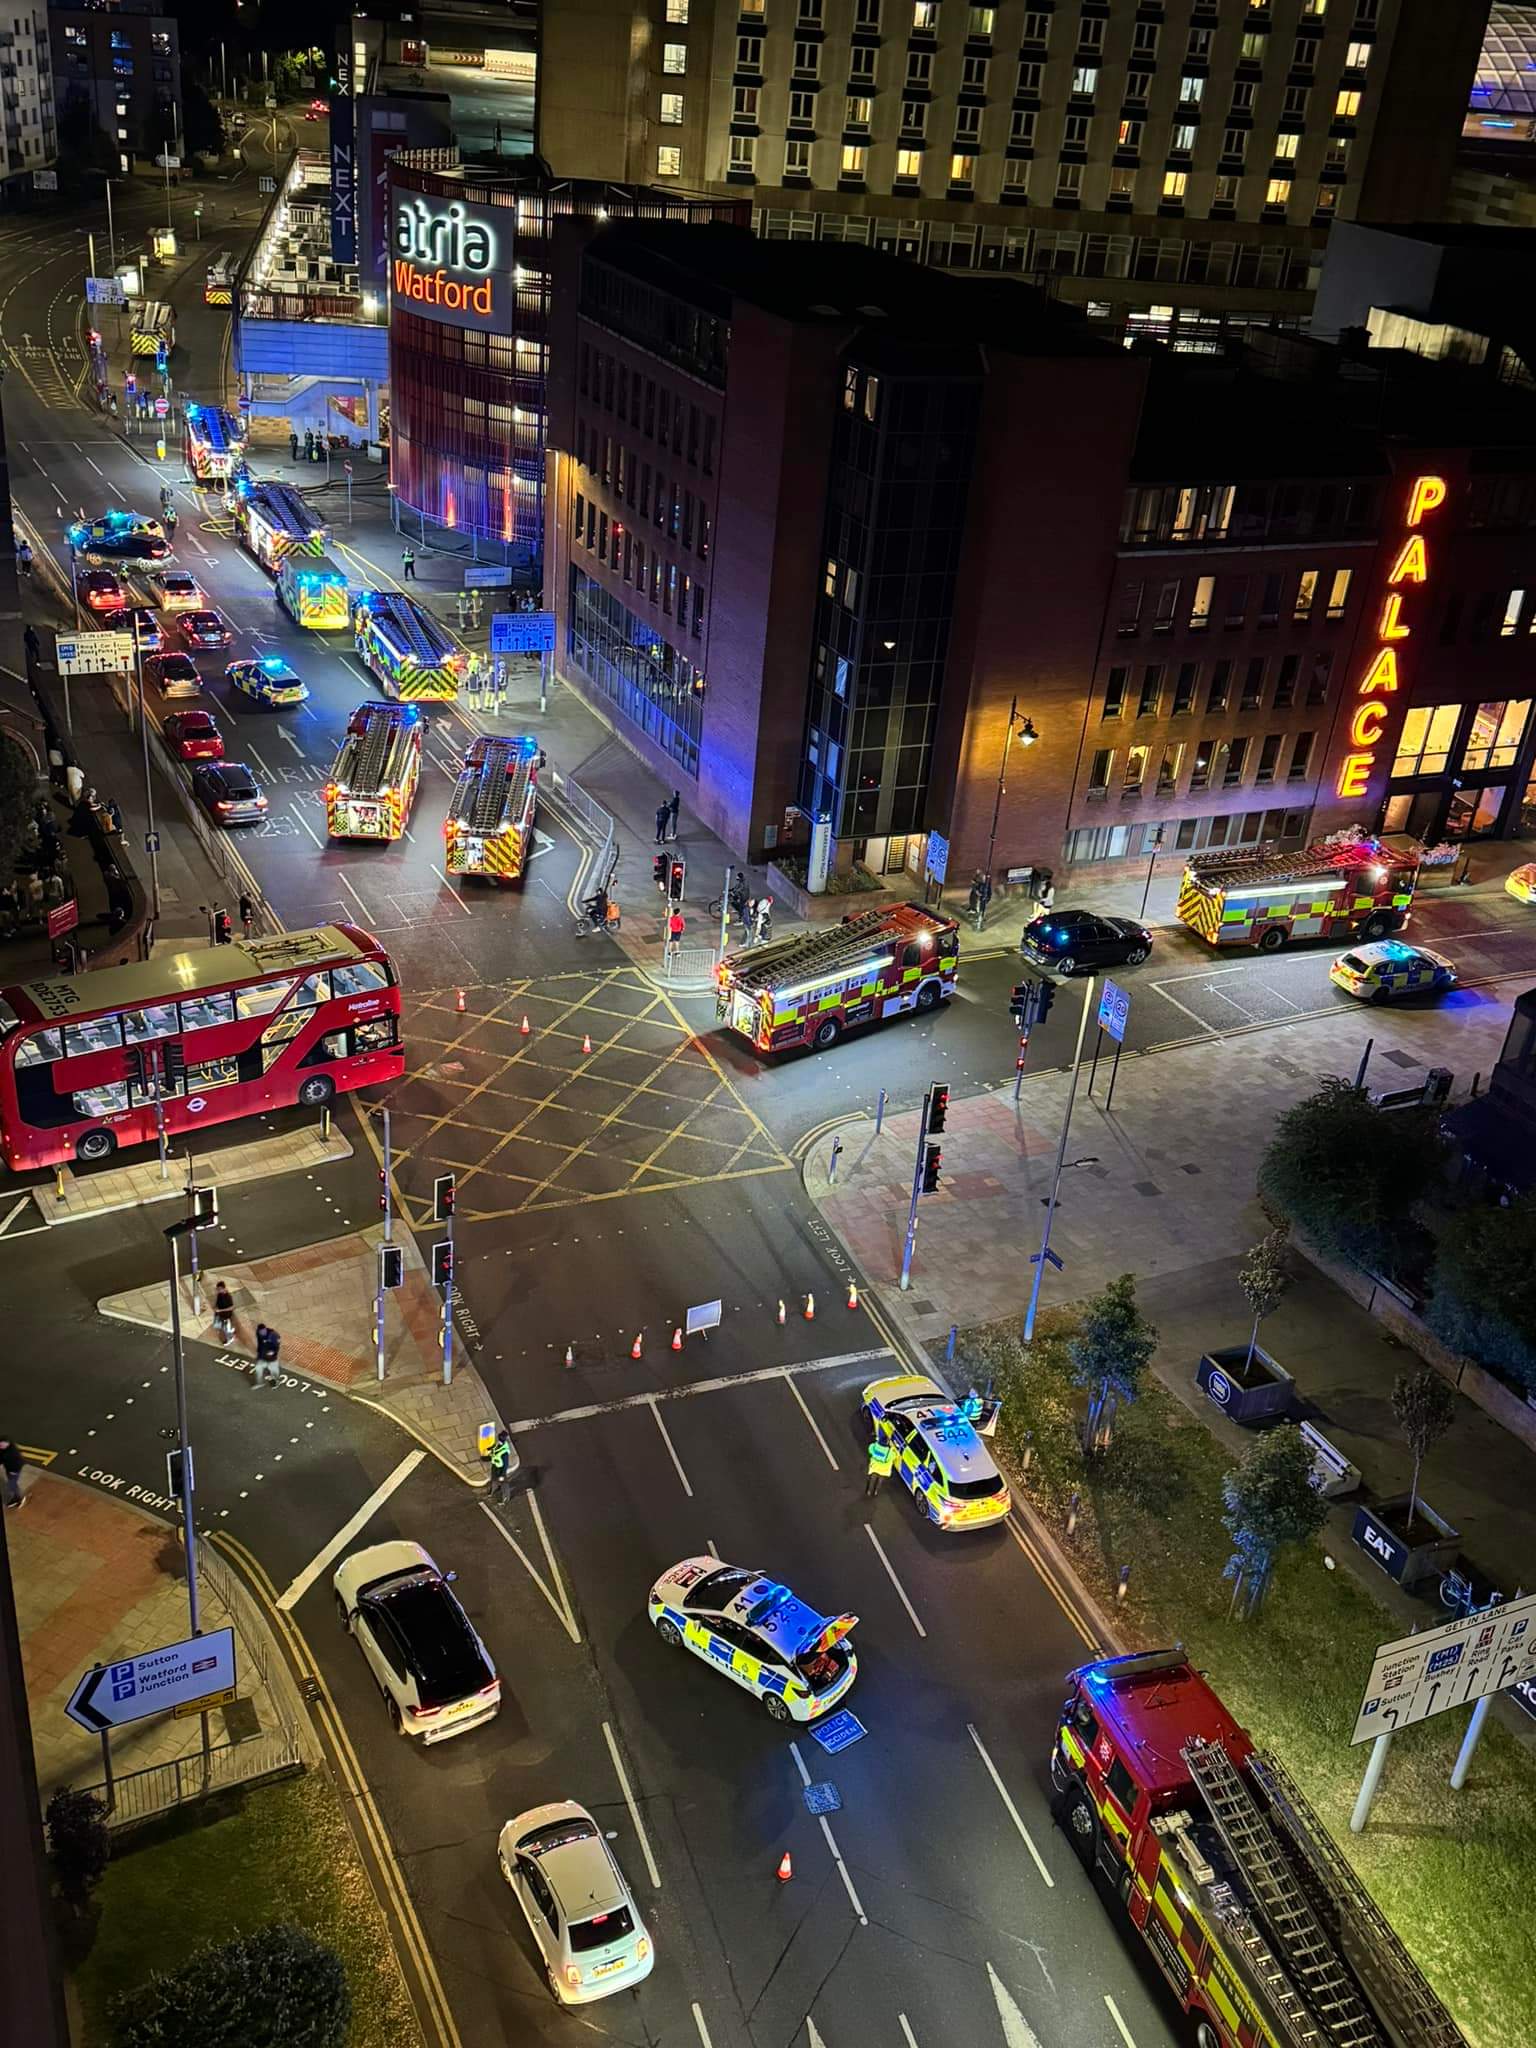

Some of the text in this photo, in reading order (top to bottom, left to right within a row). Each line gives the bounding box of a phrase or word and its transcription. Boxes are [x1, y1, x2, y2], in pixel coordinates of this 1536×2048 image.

[333, 145, 352, 236] NEXT
[397, 200, 491, 270] atria
[395, 260, 493, 314] Watford
[1337, 476, 1446, 798] PALACE
[29, 982, 70, 1016] BDE2753
[53, 984, 80, 1003] MTG
[456, 1308, 480, 1338] RIGHT
[935, 1428, 968, 1443] 544
[78, 1465, 176, 1511] LOOK RIGHT
[1363, 1526, 1396, 1560] EAT
[733, 1596, 754, 1615] 41
[762, 1601, 799, 1632] 525
[1444, 1606, 1508, 1633] GET IN LANE
[138, 1653, 179, 1671] Sutton
[139, 1663, 187, 1684] Watford
[1382, 1655, 1420, 1673] Junction
[1382, 1664, 1416, 1680] Station
[140, 1673, 189, 1694] Junction
[1381, 1691, 1412, 1706] Sutton
[815, 1713, 849, 1737] POLICE
